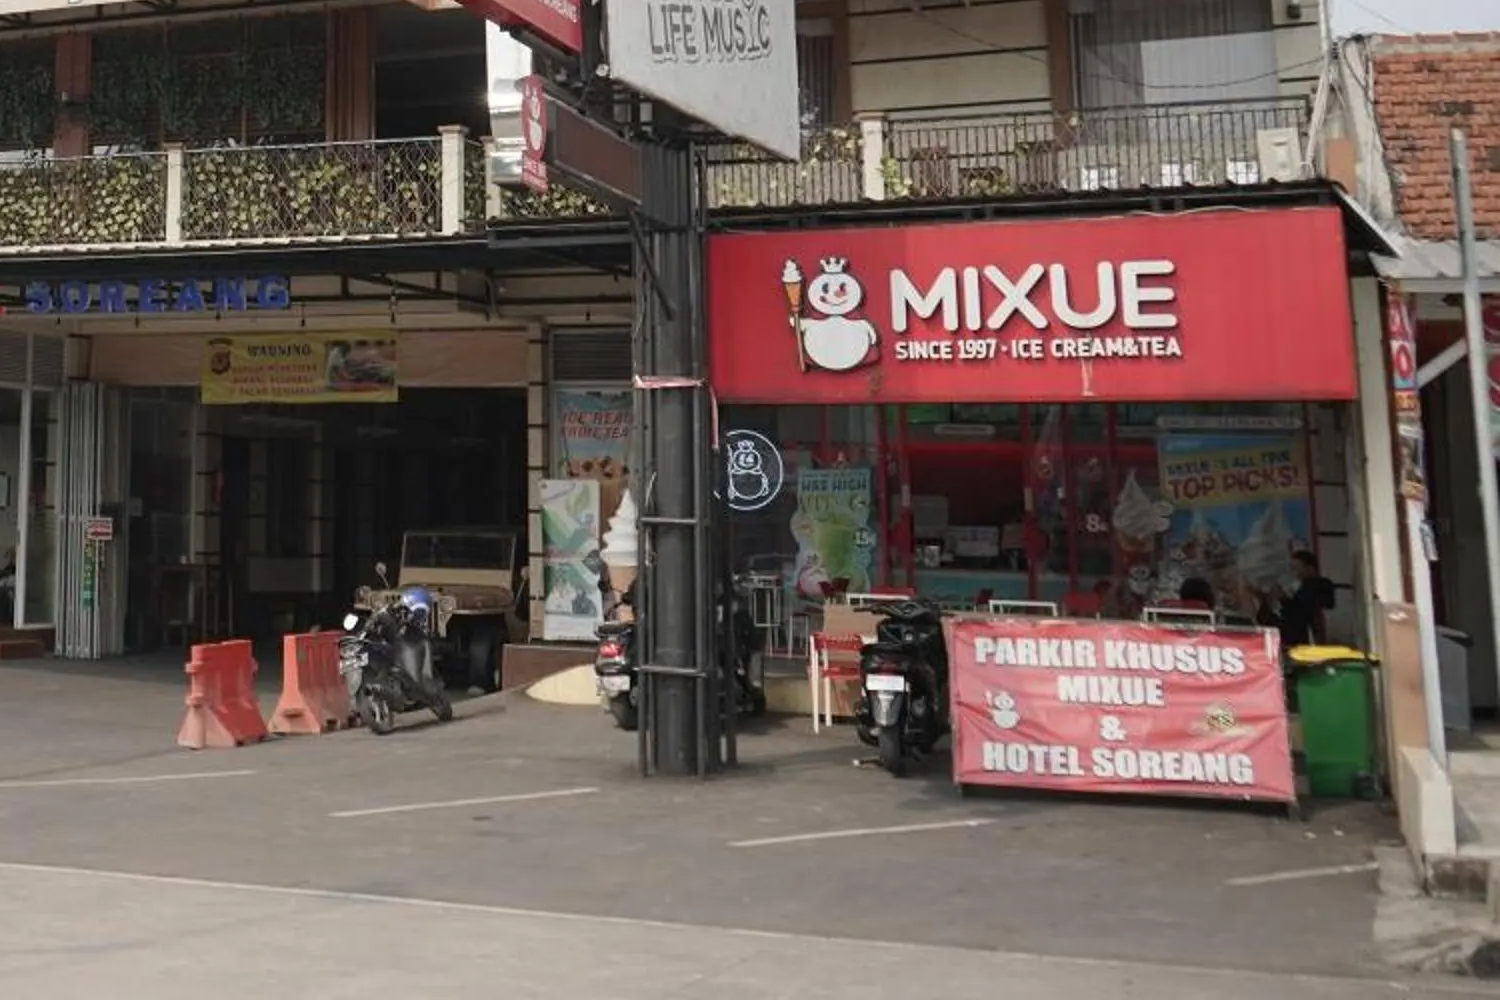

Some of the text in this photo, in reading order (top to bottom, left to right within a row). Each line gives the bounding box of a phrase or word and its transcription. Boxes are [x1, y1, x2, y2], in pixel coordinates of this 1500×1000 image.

[648, 1, 697, 57] LIFE
[23, 275, 291, 315] SOREANG
[889, 259, 1179, 333] MIXUE
[895, 340, 954, 360] SINCE
[956, 338, 997, 360] 1997
[1011, 339, 1044, 358] ICE
[1167, 474, 1215, 501] TOP
[974, 636, 1246, 674] PARKIR KHUSUS
[1057, 675, 1166, 707] MIXUE
[1098, 715, 1127, 742] &
[981, 741, 1254, 786] HOTEL SOREANG
